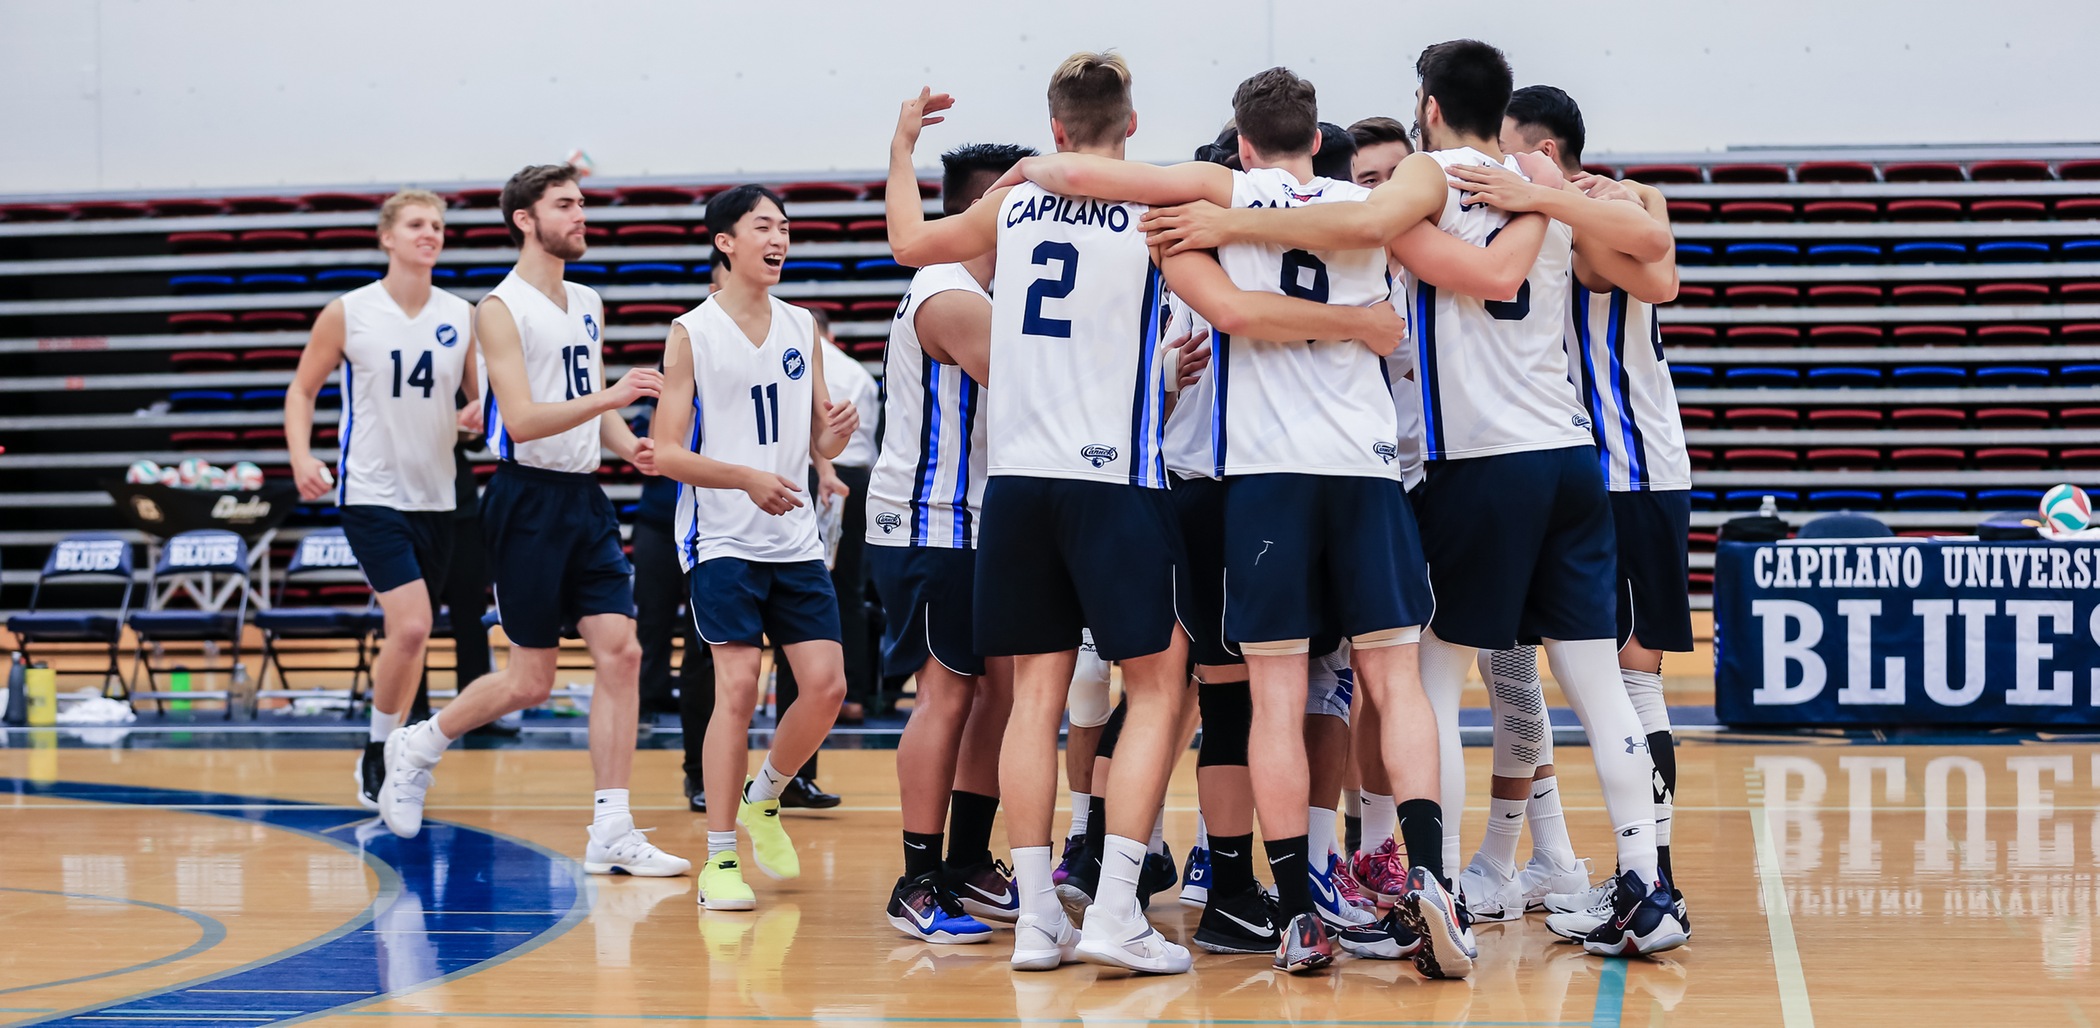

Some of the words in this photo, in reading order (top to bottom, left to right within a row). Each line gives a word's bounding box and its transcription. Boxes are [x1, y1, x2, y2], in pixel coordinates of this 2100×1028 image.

[1006, 195, 1130, 233] CAPILANO
[1021, 240, 1080, 339] 2
[390, 349, 435, 399] 14
[561, 344, 593, 401] 16
[750, 382, 779, 446] 11
[55, 549, 122, 571] BLUES
[169, 543, 238, 567] BLUES
[300, 543, 359, 567] BLUE
[1753, 546, 1923, 589] CAPILANO
[1751, 598, 2100, 707] BLUE
